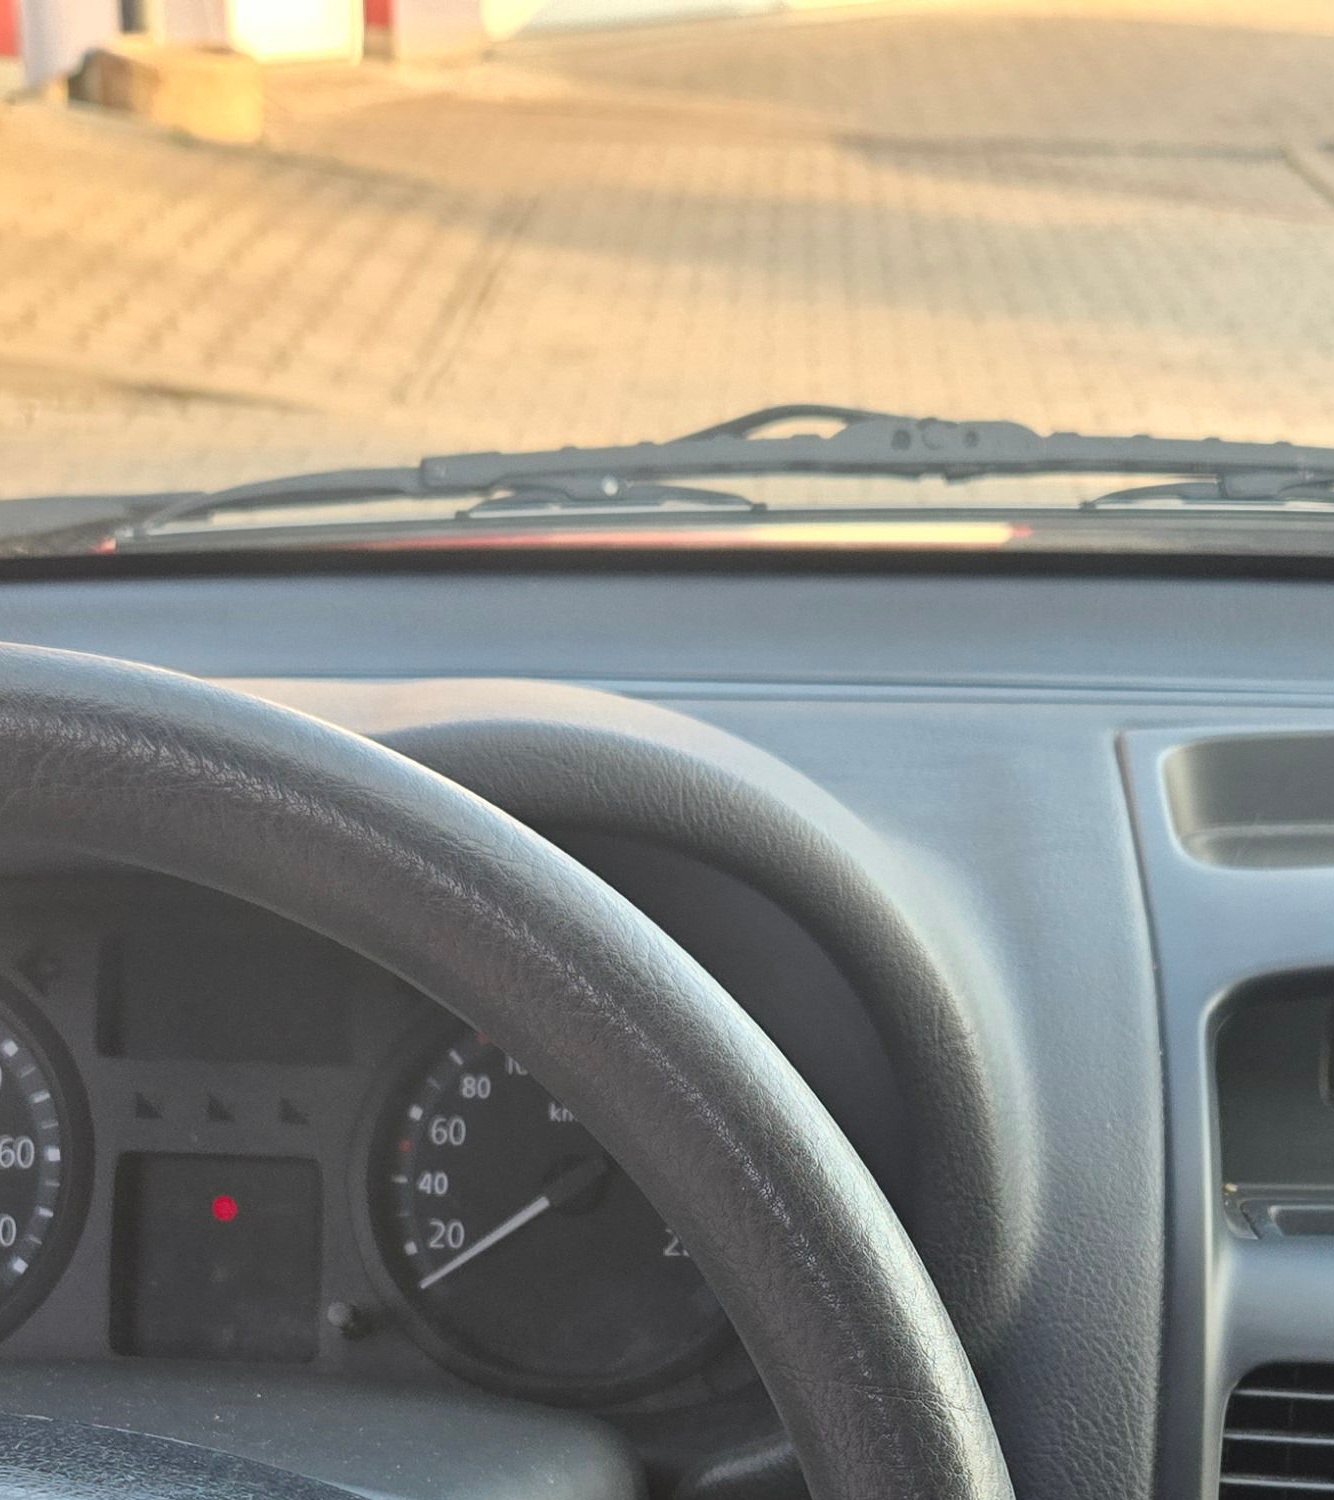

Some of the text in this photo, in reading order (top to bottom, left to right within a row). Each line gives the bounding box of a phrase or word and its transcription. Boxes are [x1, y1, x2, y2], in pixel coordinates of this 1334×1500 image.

[461, 1075, 491, 1099] 80
[430, 1117, 466, 1146] 60
[418, 1172, 448, 1196] 40
[428, 1219, 464, 1249] 20
